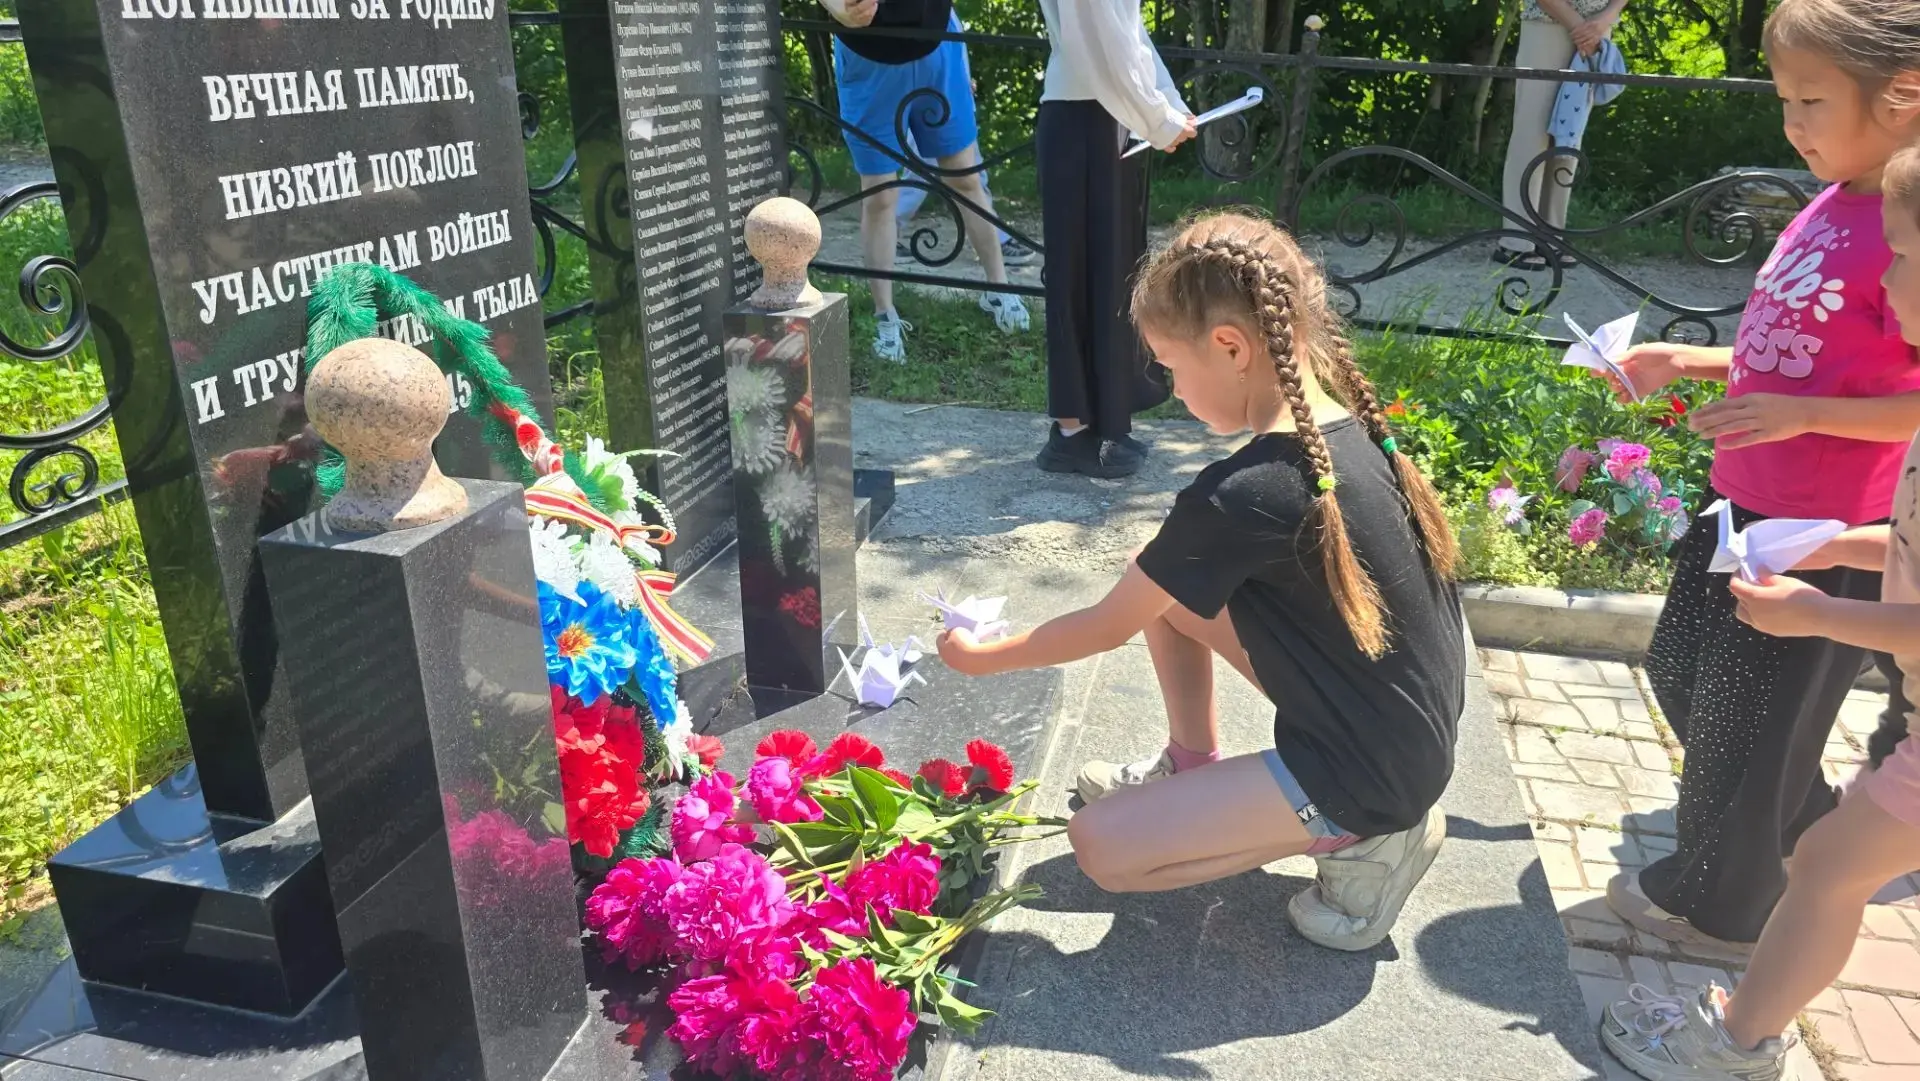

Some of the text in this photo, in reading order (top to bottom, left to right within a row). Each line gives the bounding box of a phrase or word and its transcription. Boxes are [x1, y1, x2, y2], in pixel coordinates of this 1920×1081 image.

[203, 64, 475, 121] ВЕЧНАЯ ПАМЯТЬ,
[219, 140, 478, 220] НИЗКИЙ ПОКЛОН
[427, 209, 512, 261] ВОЙНЫ
[190, 375, 225, 424] И
[473, 273, 539, 322] ТЫЛА
